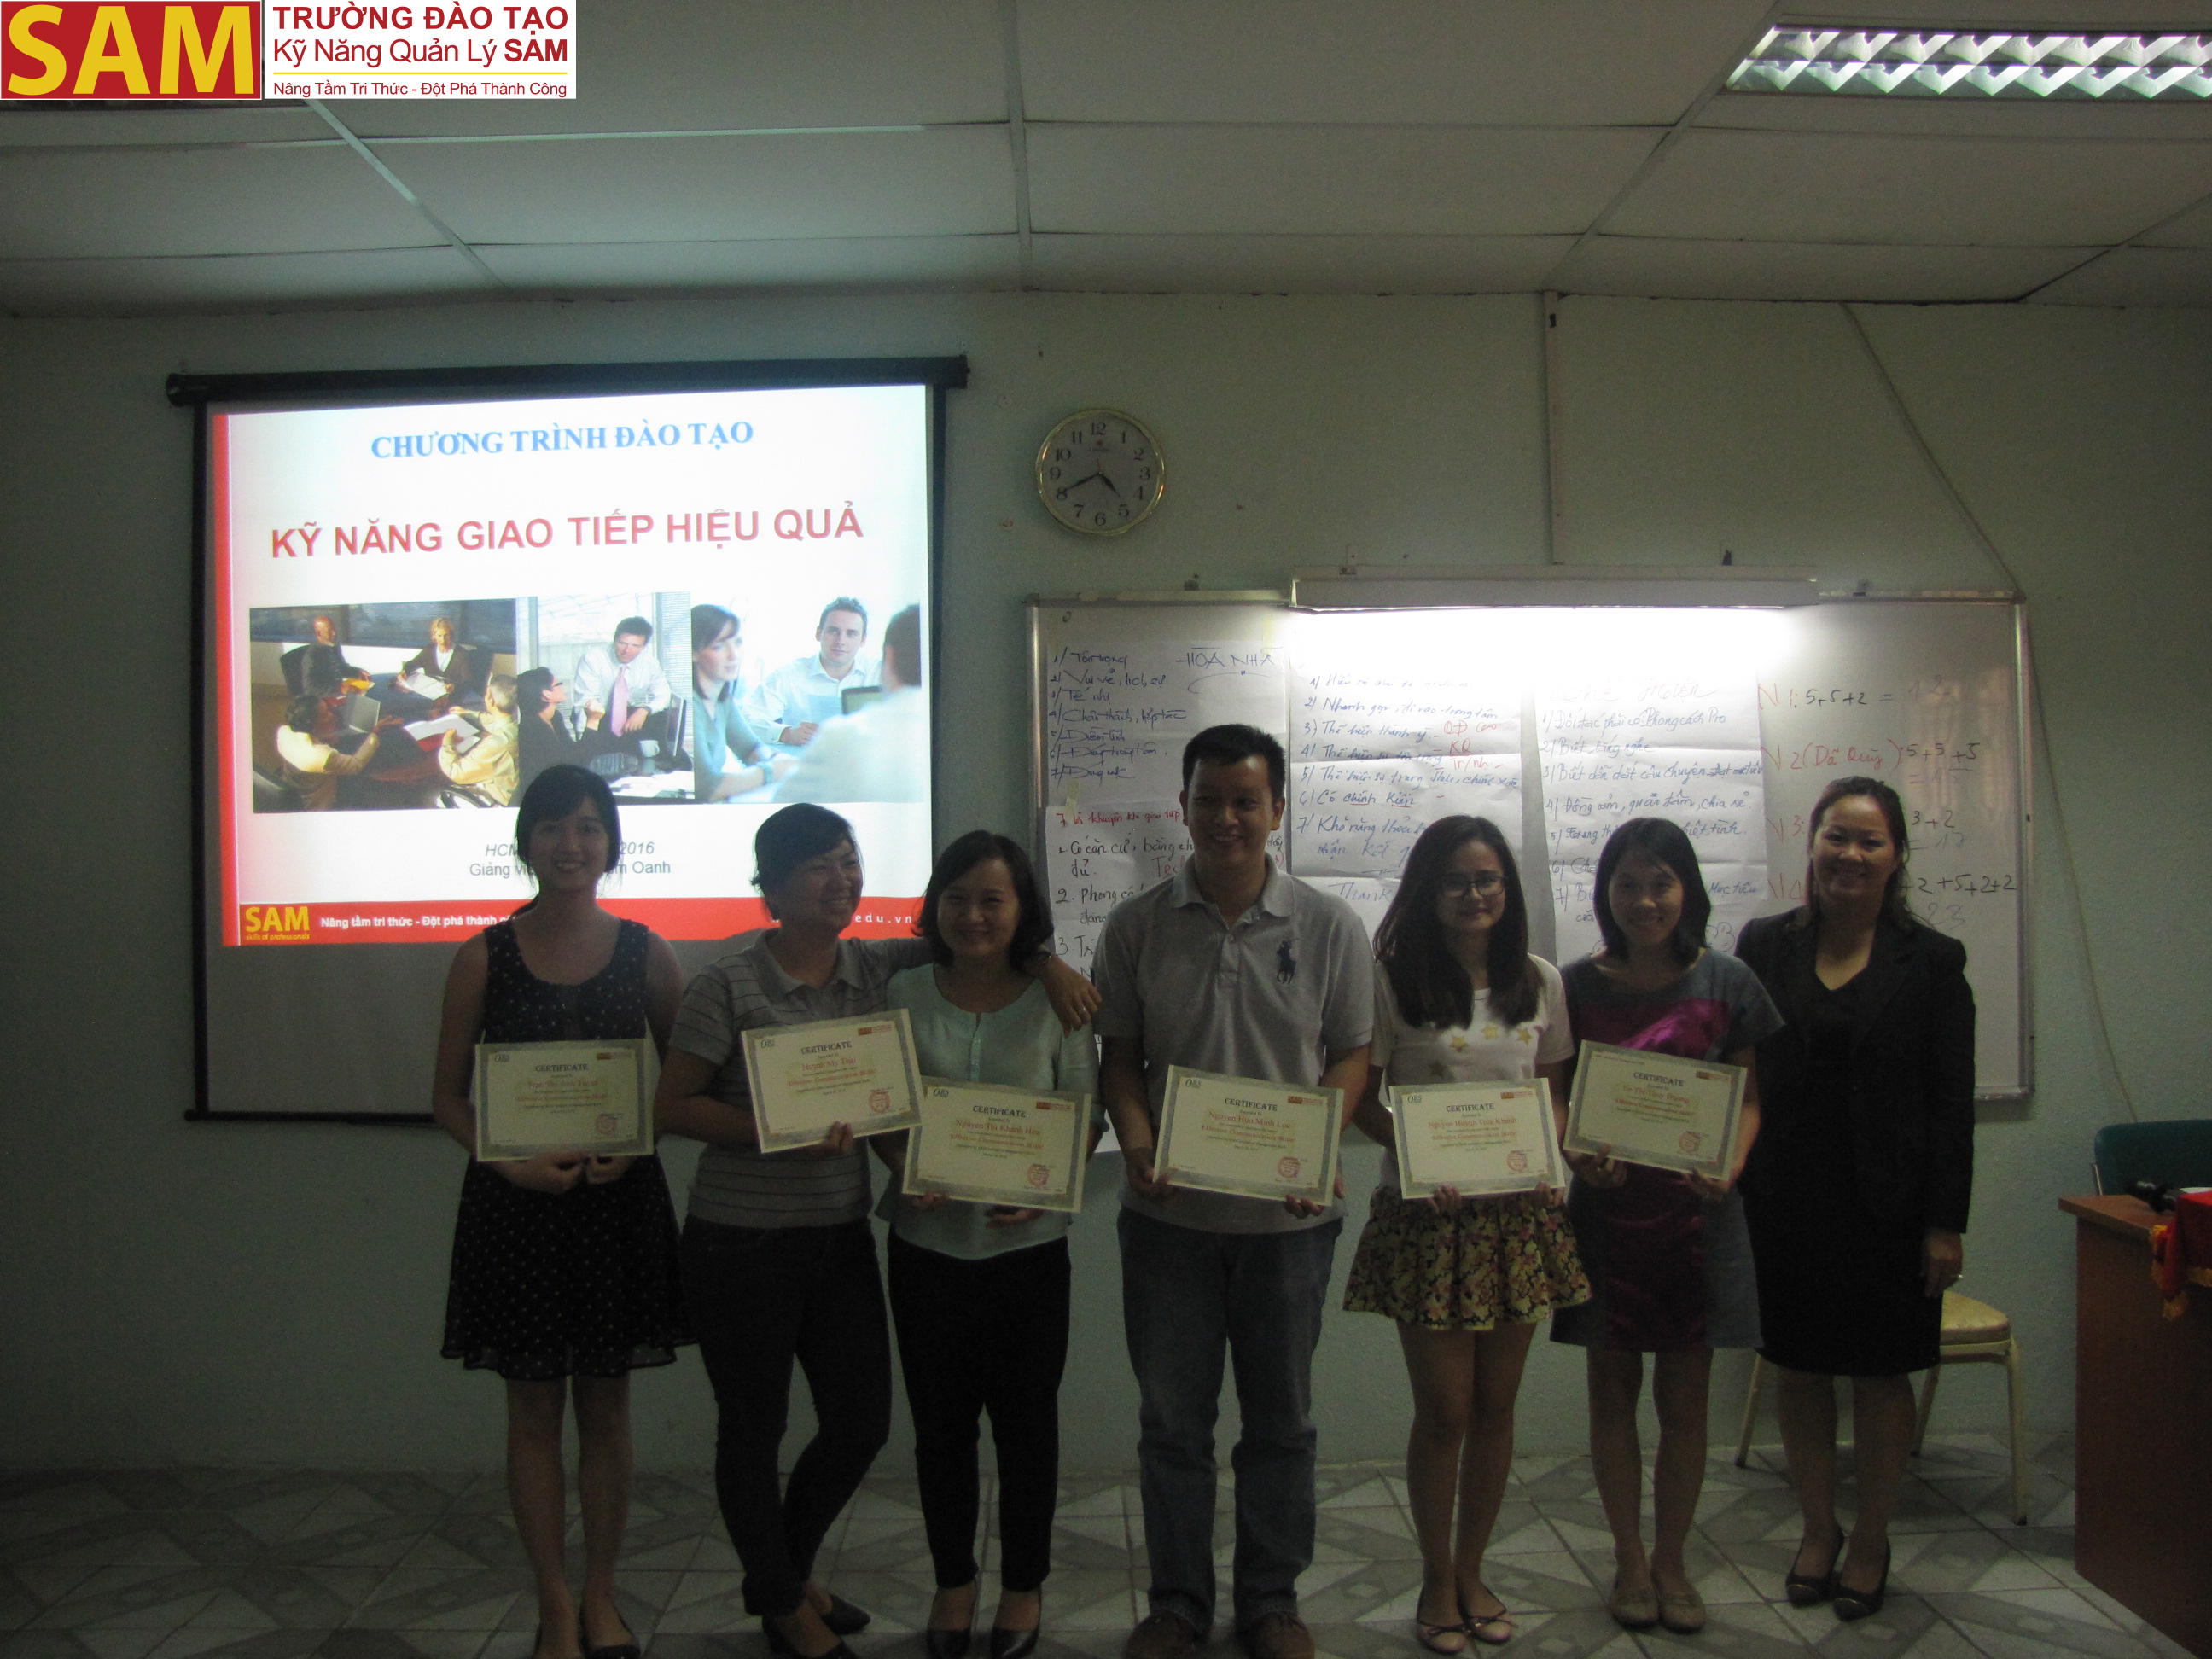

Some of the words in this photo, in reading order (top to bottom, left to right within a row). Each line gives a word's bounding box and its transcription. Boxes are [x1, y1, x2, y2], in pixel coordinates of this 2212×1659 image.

[1091, 422, 1106, 435] 12
[371, 430, 503, 459] CHƯƠNG
[510, 422, 607, 451] TRÌNH
[614, 418, 680, 448] ĐÀO
[687, 421, 754, 450] TẠO
[1072, 431, 1082, 444] 11
[1055, 448, 1071, 462] 10
[1134, 448, 1144, 461] 2
[1050, 467, 1061, 480] 9
[1140, 467, 1150, 480] 3
[1057, 487, 1068, 501] 8
[1074, 504, 1084, 518] 7
[1119, 504, 1129, 517] 5
[1095, 513, 1106, 526] 6
[272, 521, 322, 558] KỸ
[335, 518, 443, 556] NĂNG
[458, 518, 553, 550] GIAO
[568, 508, 654, 546] TIẾP
[667, 508, 759, 549] HIỆU
[774, 500, 864, 541] QUẢ
[469, 862, 510, 879] Giảng
[632, 860, 671, 874] Oanh
[245, 906, 310, 932] SAM
[321, 917, 349, 930] Nâng
[801, 1041, 853, 1055] CERTIFICATE
[1225, 1097, 1278, 1111] CERTIFICATE
[1446, 1103, 1494, 1112] CERTIFICATE
[973, 1105, 1027, 1117] CERTIFICATE
